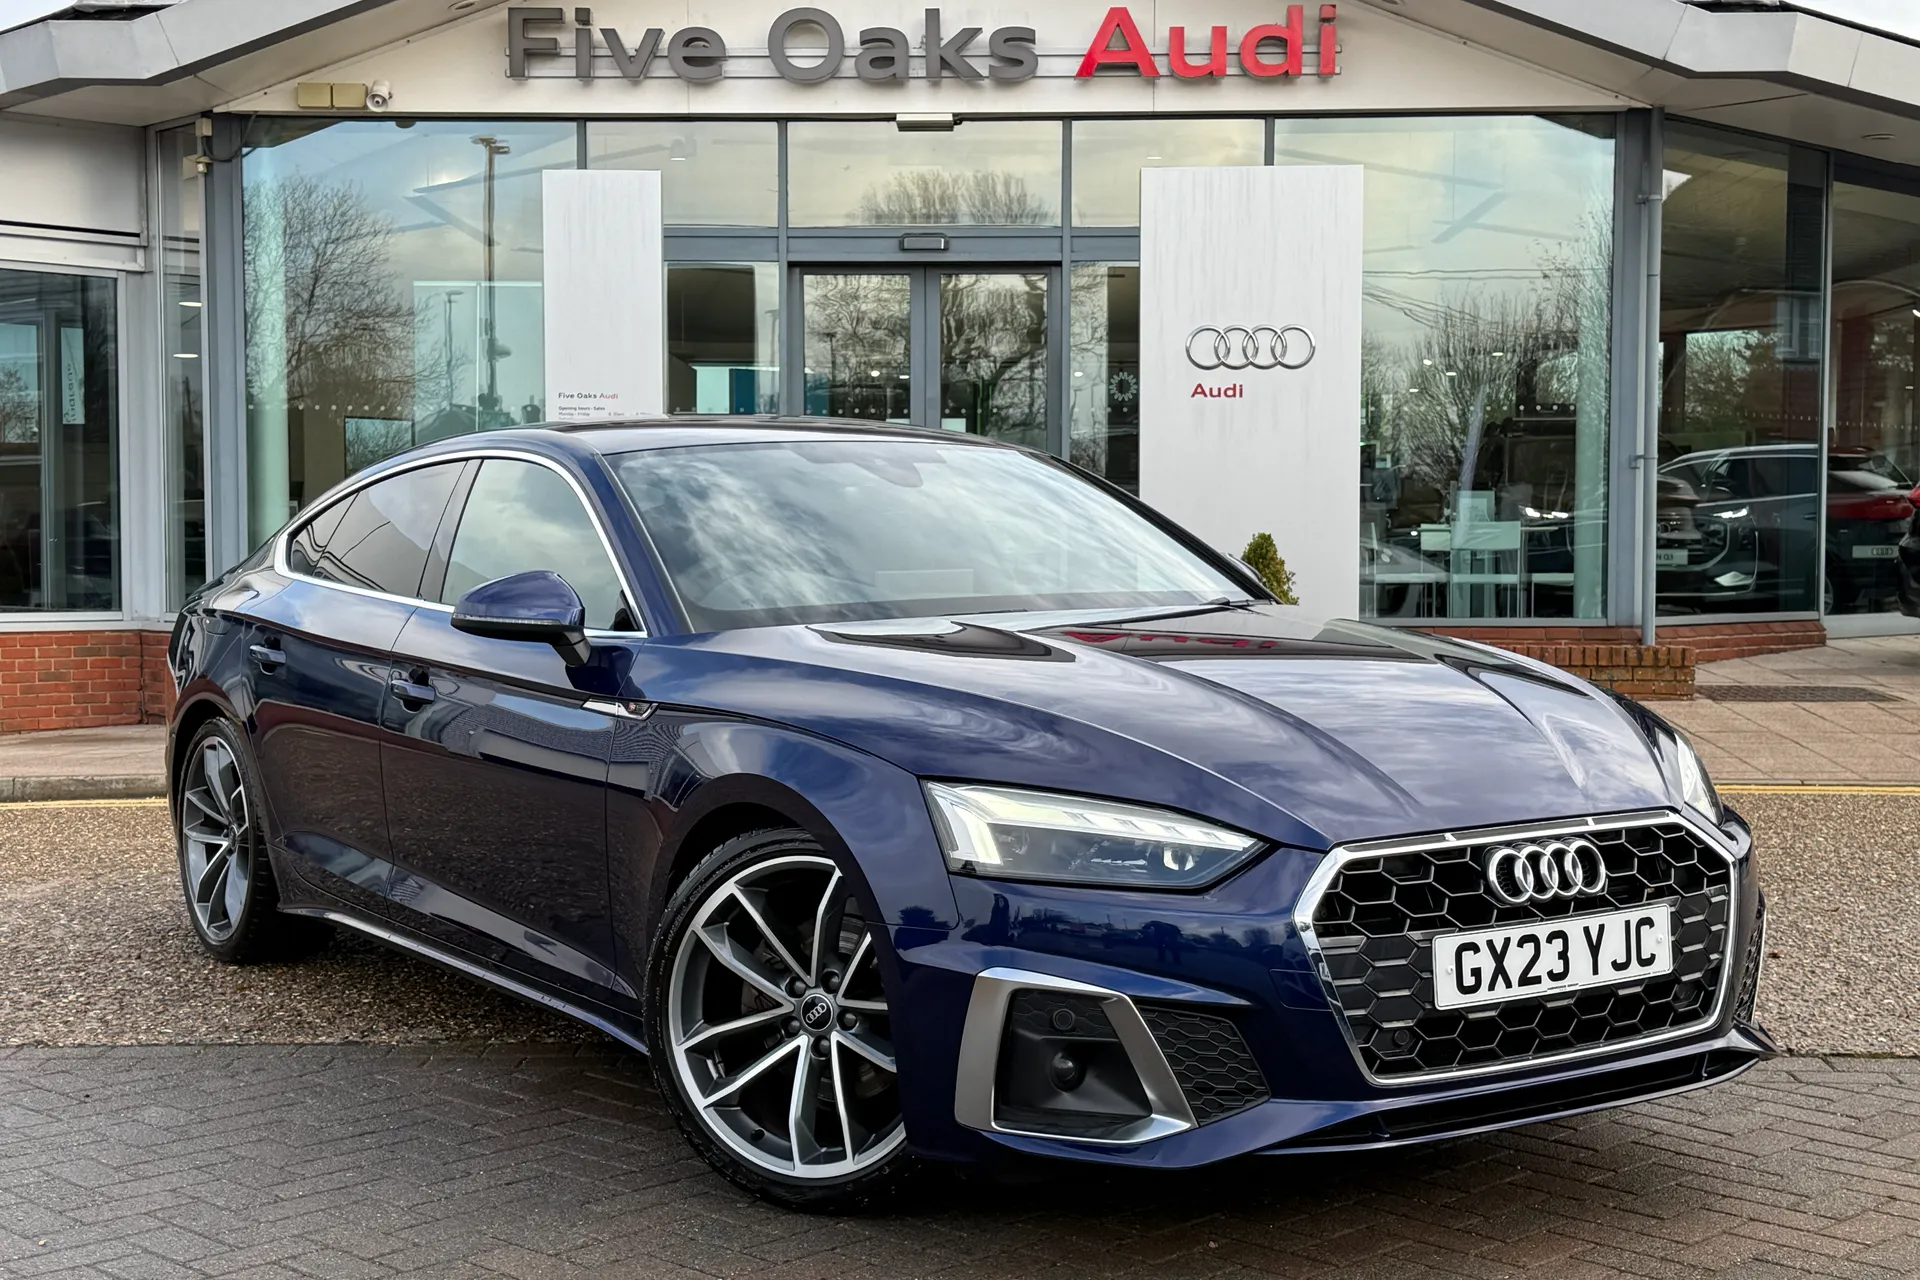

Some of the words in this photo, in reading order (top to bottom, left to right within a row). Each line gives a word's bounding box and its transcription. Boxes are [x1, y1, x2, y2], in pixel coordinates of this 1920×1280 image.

[508, 7, 727, 82] Five
[767, 7, 1038, 82] Oaks
[1075, 4, 1338, 79] Audi
[1191, 383, 1243, 398] Audi
[1454, 930, 1570, 996] GX23
[1583, 916, 1657, 976] YJC
